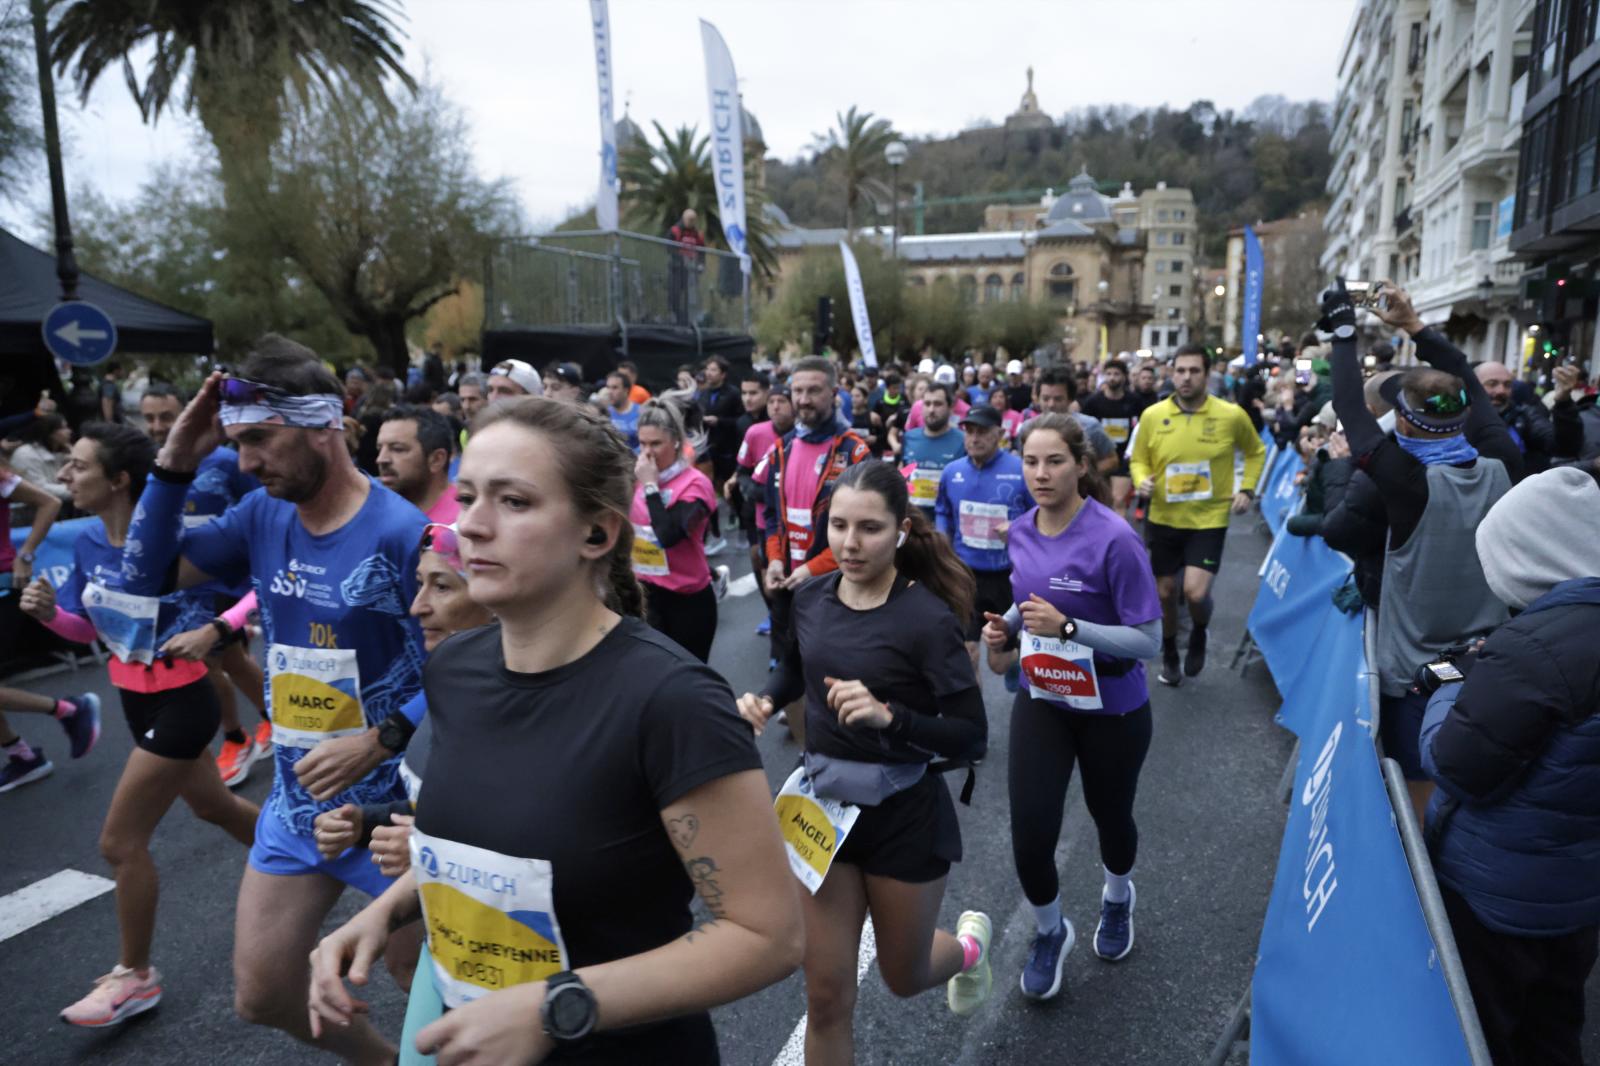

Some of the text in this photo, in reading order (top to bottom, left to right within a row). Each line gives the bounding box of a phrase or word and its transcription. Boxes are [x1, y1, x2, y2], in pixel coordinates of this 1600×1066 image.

[1043, 642, 1079, 653] ZURICH
[293, 657, 336, 671] ZURICH
[1034, 666, 1087, 682] MADINA
[288, 694, 336, 710] MARC
[792, 811, 834, 853] ANGELA
[446, 862, 517, 896] ZURICH
[469, 940, 561, 963] CHEYENNE
